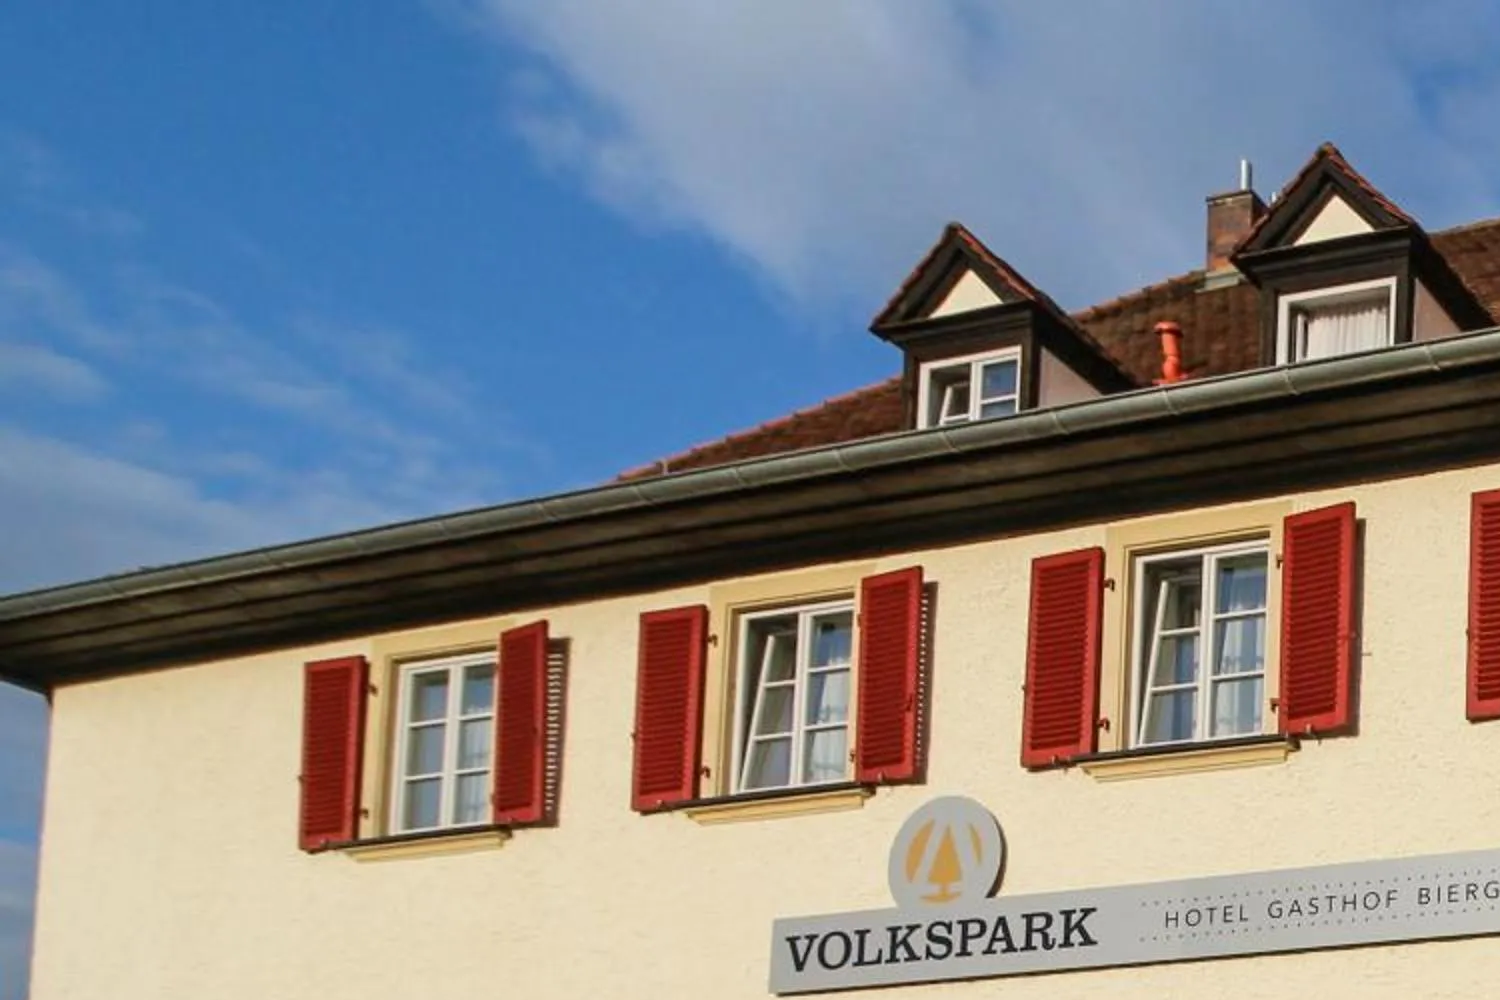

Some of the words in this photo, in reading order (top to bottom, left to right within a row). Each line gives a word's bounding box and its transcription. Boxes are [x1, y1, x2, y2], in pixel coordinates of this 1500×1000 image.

[1165, 904, 1249, 929] HOTEL
[1266, 889, 1399, 920] GASTHOF
[785, 906, 1098, 973] VOLKSPARK
